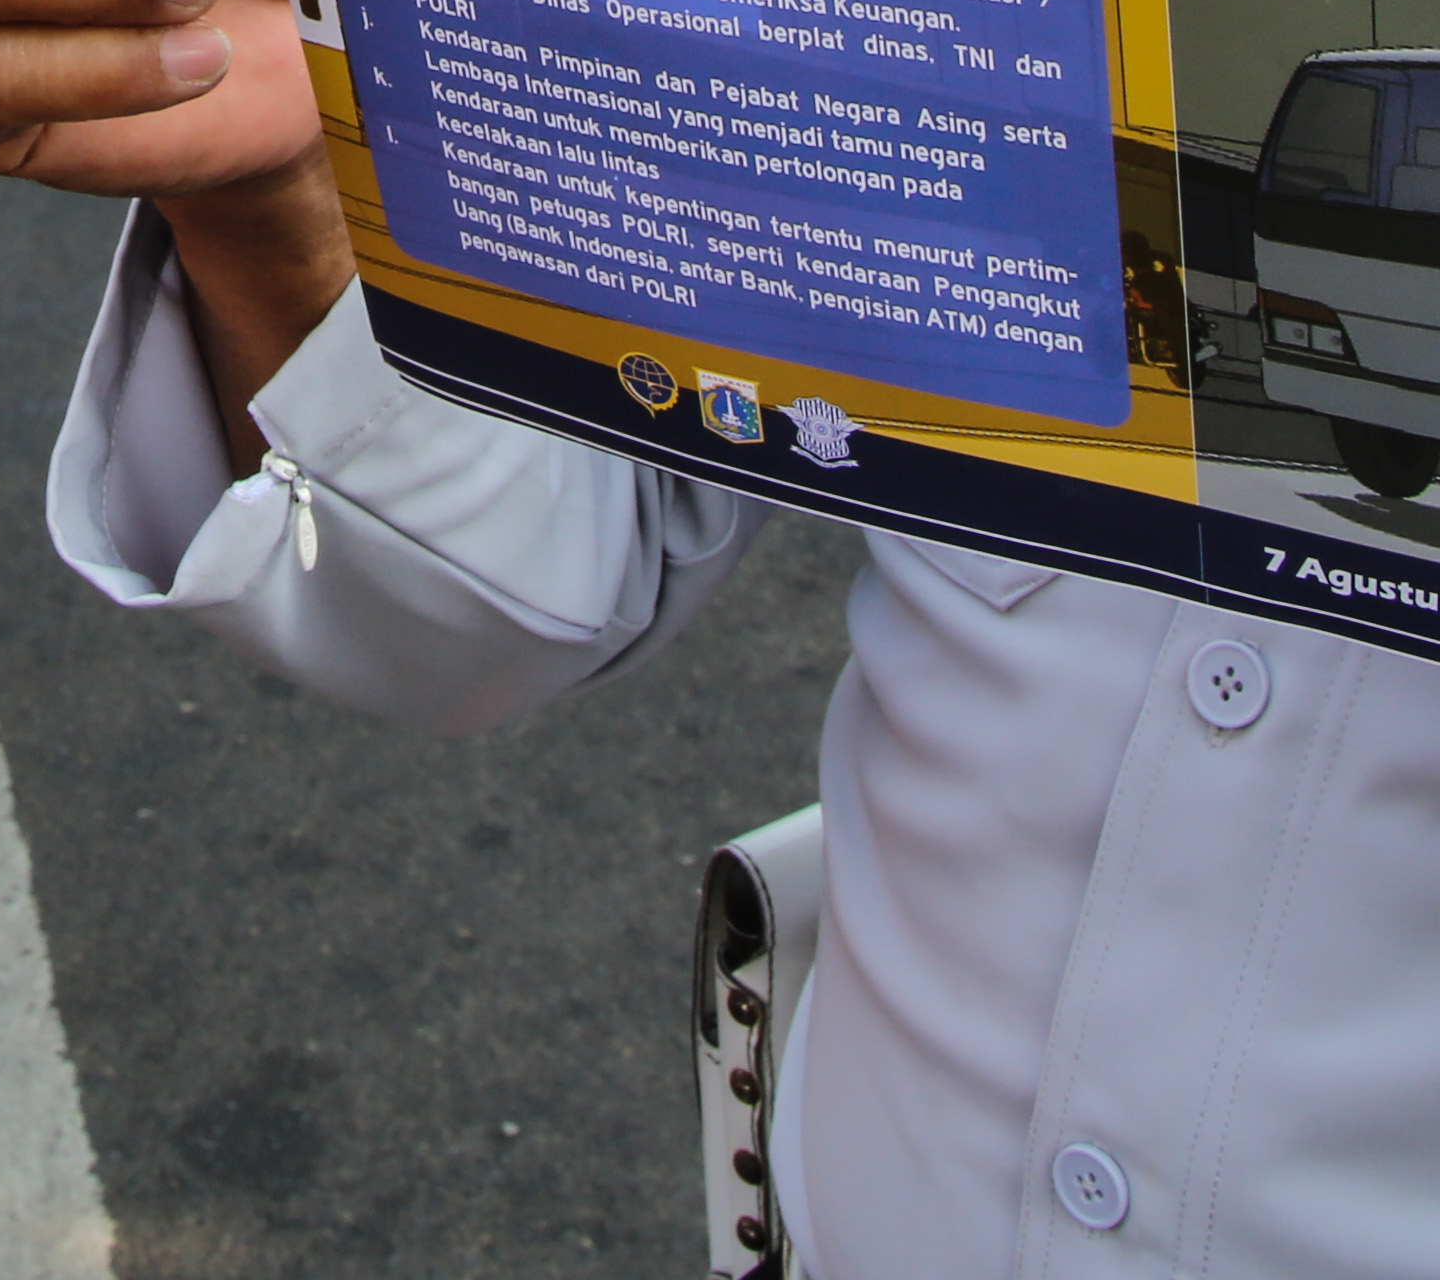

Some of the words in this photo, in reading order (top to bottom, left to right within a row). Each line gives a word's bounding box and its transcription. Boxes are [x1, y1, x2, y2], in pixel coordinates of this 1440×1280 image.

[418, 19, 528, 63] Kendaraan
[538, 46, 642, 86] Pimpinan
[655, 70, 697, 96] dan
[709, 78, 800, 112] Pejabat
[813, 92, 901, 126] Negara
[917, 107, 987, 144] Asing
[1003, 124, 1068, 150] serta
[424, 49, 520, 93] Lembaga
[524, 72, 662, 120] Internasional
[667, 106, 725, 138] yang
[730, 117, 824, 149] menjadi
[830, 129, 894, 158] tamu
[899, 142, 986, 172] negara
[757, 18, 845, 52] berplat
[863, 33, 935, 65] dinas,
[952, 43, 995, 71] TNI
[1015, 53, 1062, 80] dan
[430, 79, 539, 125] Kendaraan
[542, 111, 604, 139] untuk
[608, 124, 749, 168] memberikan
[754, 153, 896, 193] pertolongan
[902, 176, 964, 202] pada
[436, 110, 552, 157] kecelakaan
[556, 140, 596, 167] lalu
[600, 149, 661, 180] lintas
[441, 139, 549, 186] Kendaraan
[556, 173, 619, 202] untuk
[624, 184, 761, 233] kepentingan
[769, 215, 863, 252] tertentu
[873, 238, 975, 270] menurut
[986, 255, 1079, 285] pertim-
[446, 169, 520, 207] bangan
[529, 195, 612, 229] petugas
[621, 213, 695, 250] POLRI,
[706, 236, 784, 268] seperti
[795, 251, 921, 294] kendaraan
[933, 275, 1081, 321] Pengangkut
[459, 230, 581, 279] pengawasan
[585, 264, 626, 291] dari
[630, 274, 697, 308] POLRI
[452, 197, 504, 234] Uang
[506, 213, 565, 247] (Bank
[568, 229, 675, 275] Indonesia,
[679, 260, 736, 287] antar
[740, 269, 804, 303] Bank,
[808, 288, 921, 326] pengisian
[926, 307, 987, 339] ATM)
[993, 319, 1084, 354] dengan
[1264, 546, 1286, 572] 7
